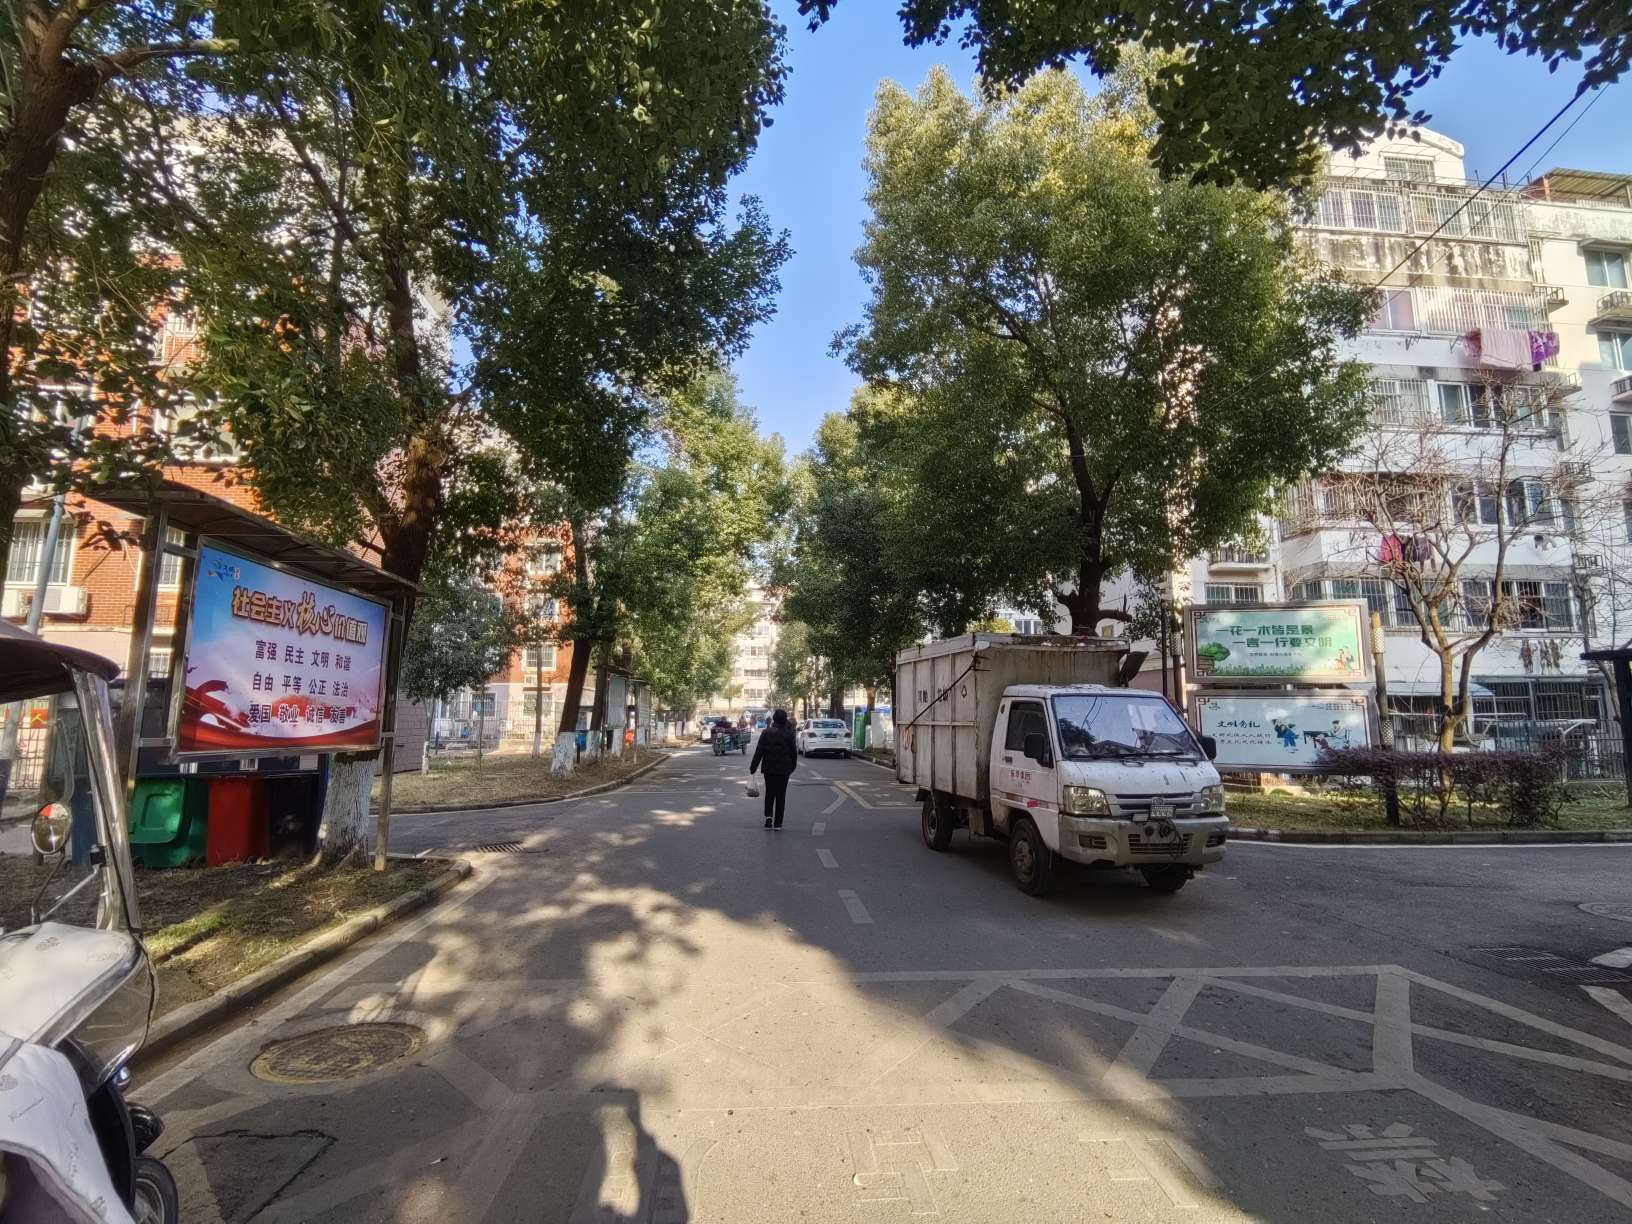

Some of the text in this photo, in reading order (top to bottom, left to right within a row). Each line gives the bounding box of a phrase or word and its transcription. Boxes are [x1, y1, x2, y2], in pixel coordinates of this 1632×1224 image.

[232, 585, 368, 645] 社会主义核心价值观
[1216, 624, 1314, 636] 一花一木皆是景
[1232, 637, 1332, 648] 一言一行要文明
[255, 640, 351, 671] 富强 民主 文明 和谐
[252, 672, 348, 697] 自由 平等 公正 法治
[248, 703, 346, 724] 爱国 敬业 诚信 友善
